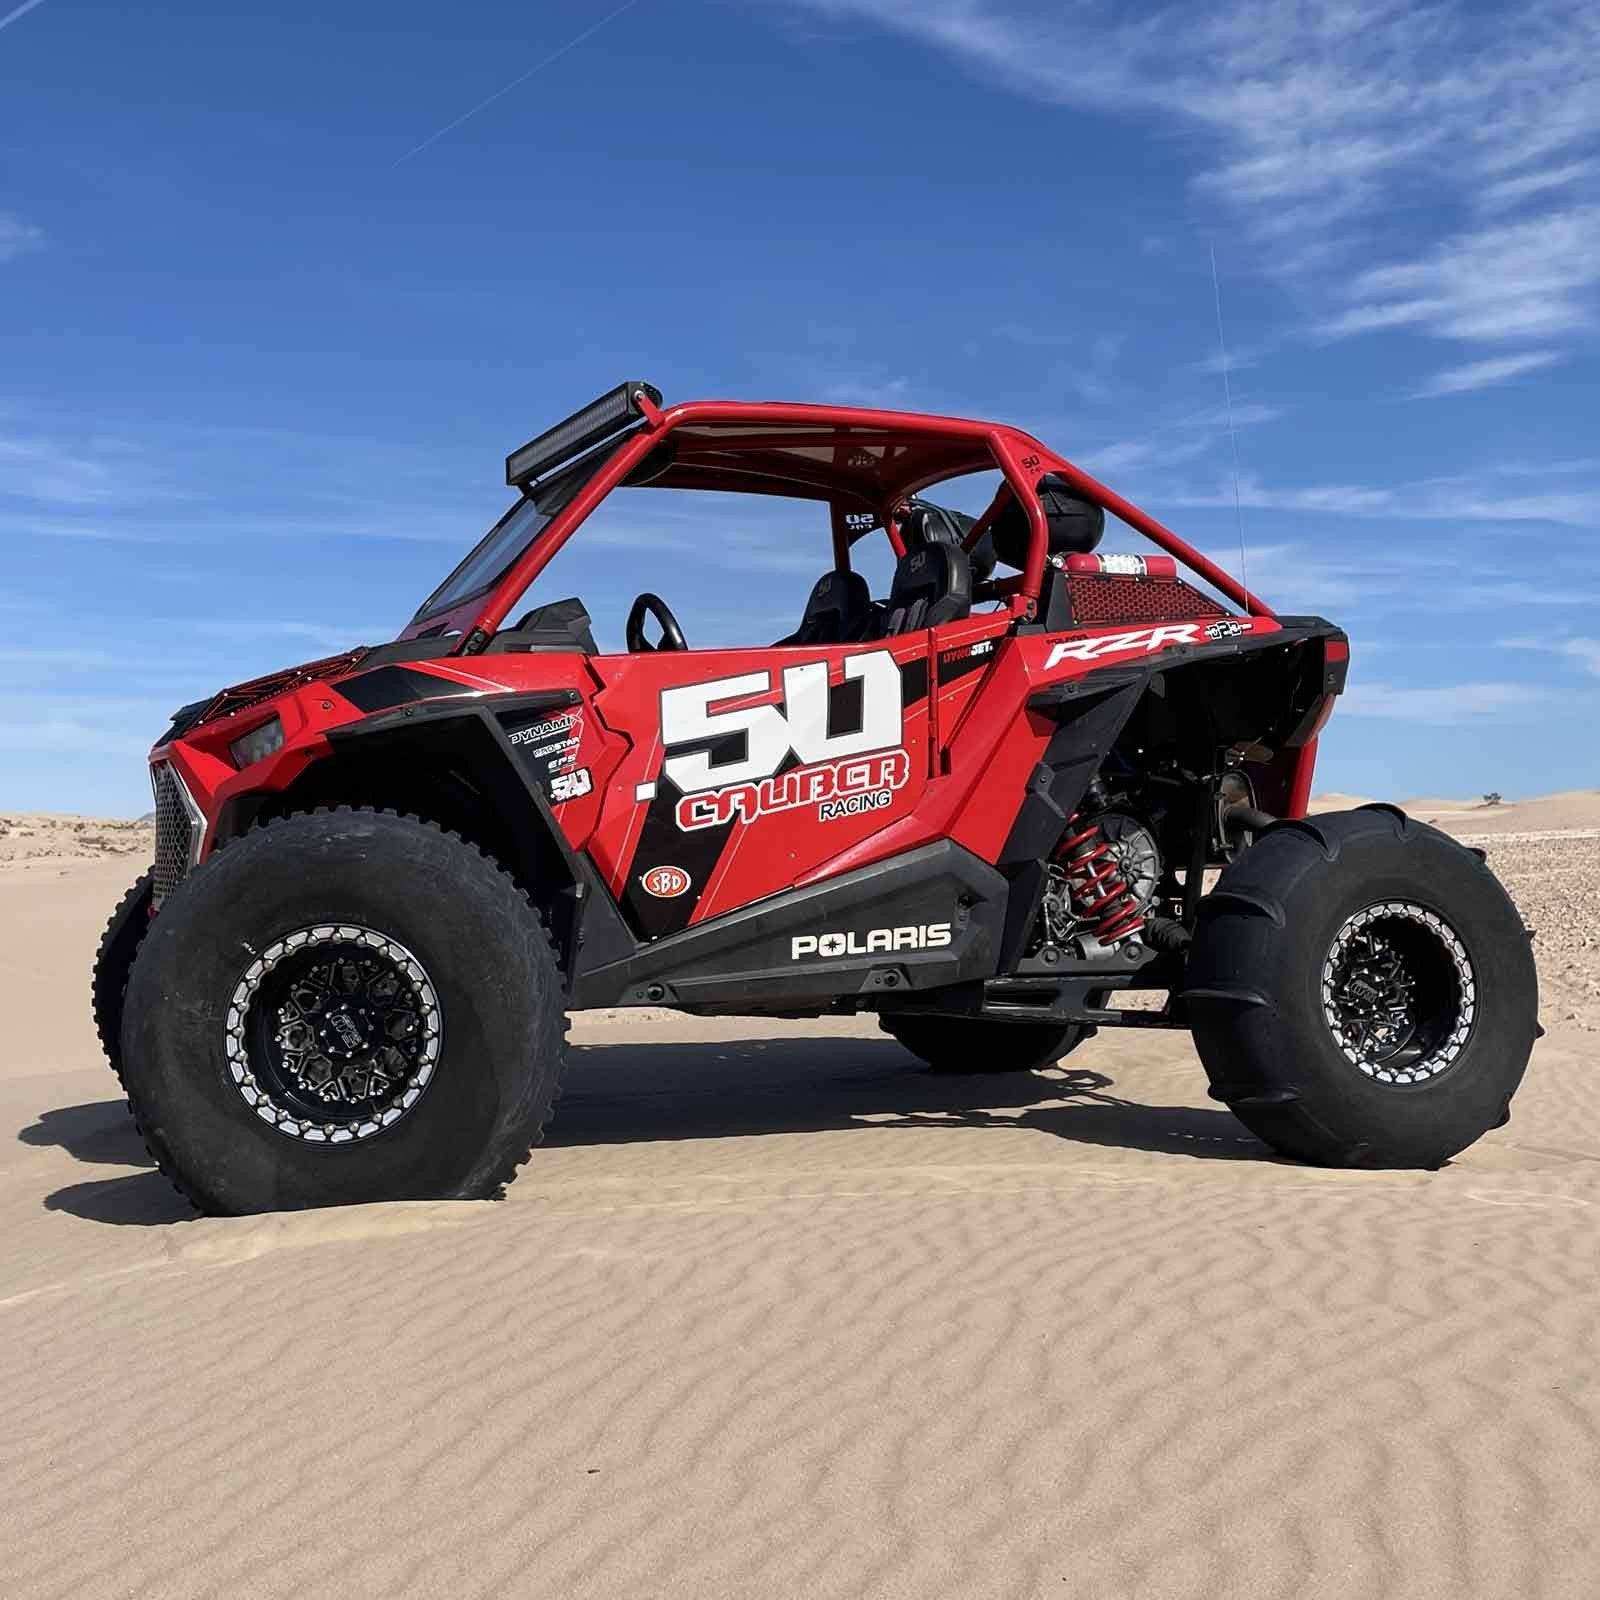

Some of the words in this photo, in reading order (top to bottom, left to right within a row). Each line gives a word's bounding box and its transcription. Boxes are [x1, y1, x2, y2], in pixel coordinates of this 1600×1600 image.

[1044, 623, 1200, 671] RZR
[818, 790, 890, 822] RACING
[651, 873, 682, 894] SBD
[791, 922, 951, 960] POLARIS
